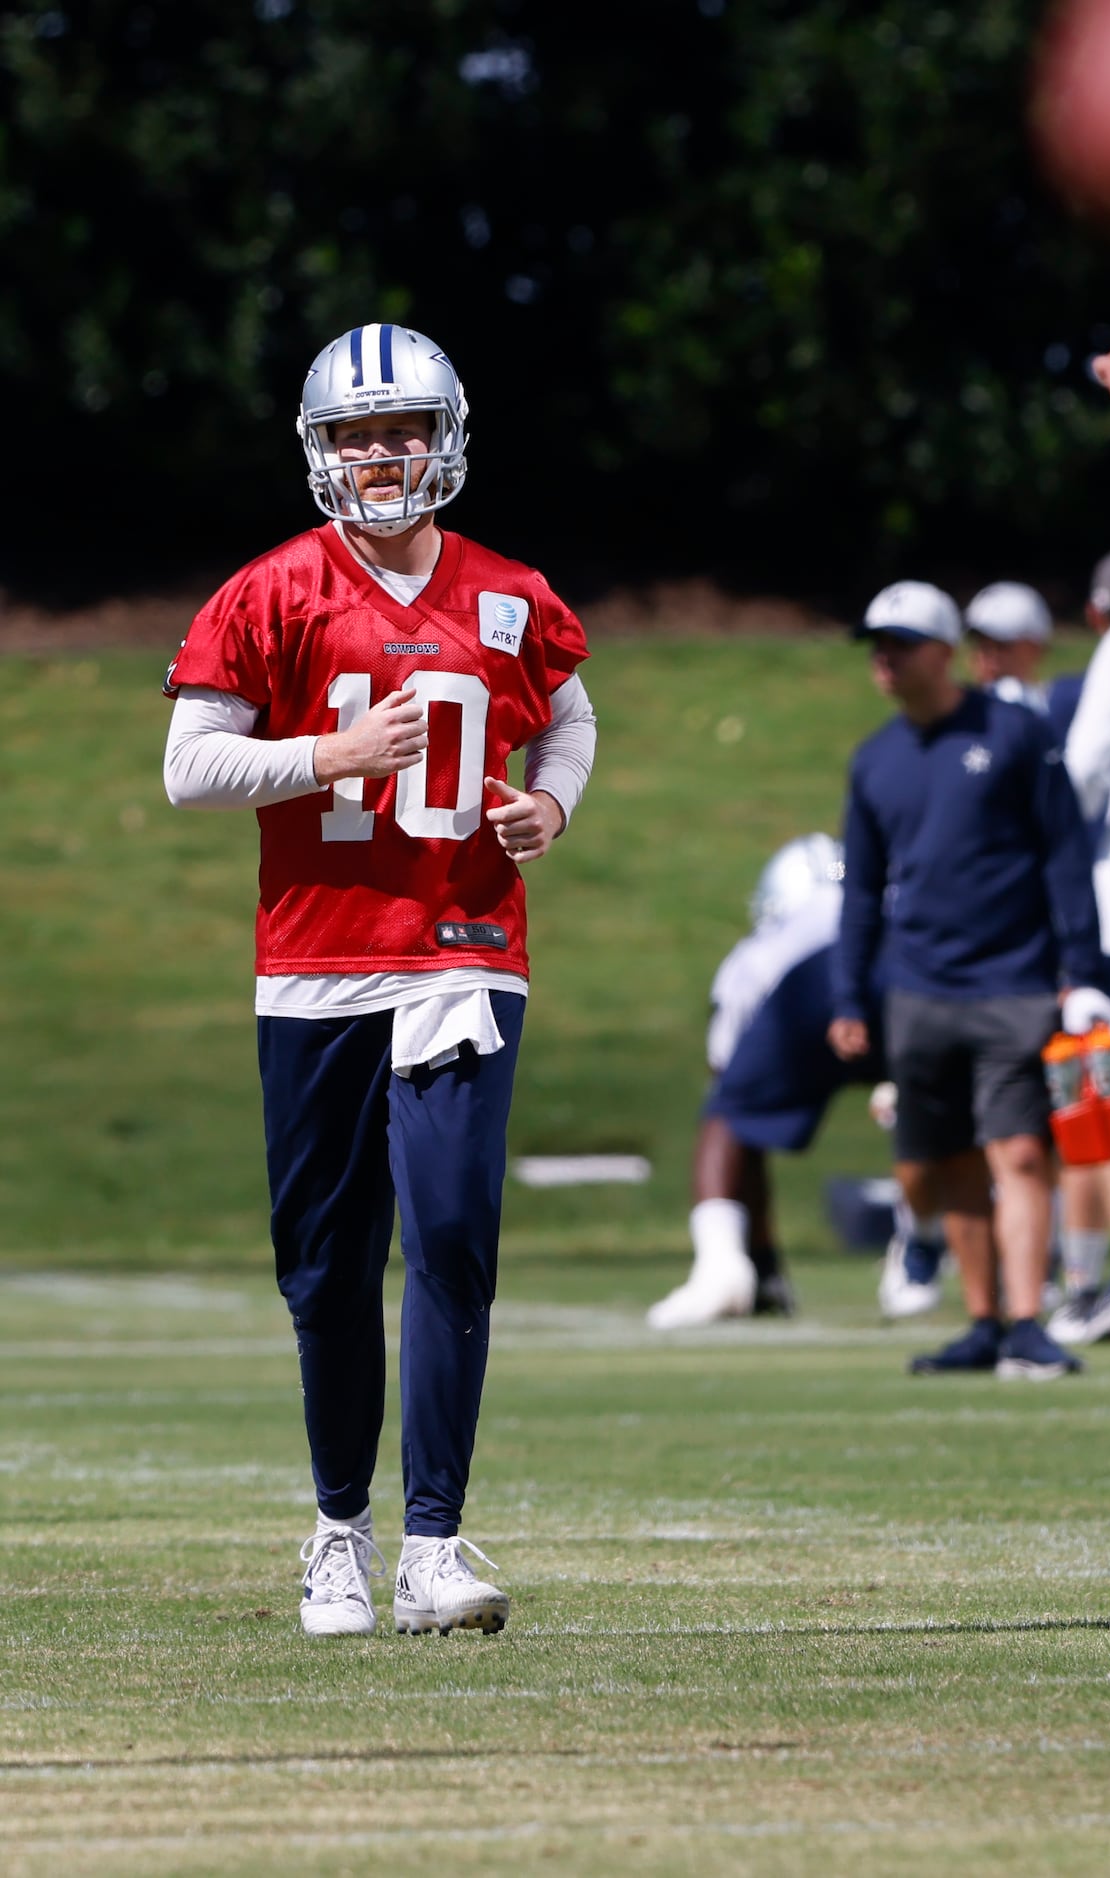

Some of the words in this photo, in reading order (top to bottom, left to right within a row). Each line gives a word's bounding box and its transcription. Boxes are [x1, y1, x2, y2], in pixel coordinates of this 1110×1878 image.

[355, 389, 391, 399] COWBOYS
[491, 630, 518, 647] AT&T
[384, 642, 440, 655] COWBOYS
[321, 670, 490, 842] 10
